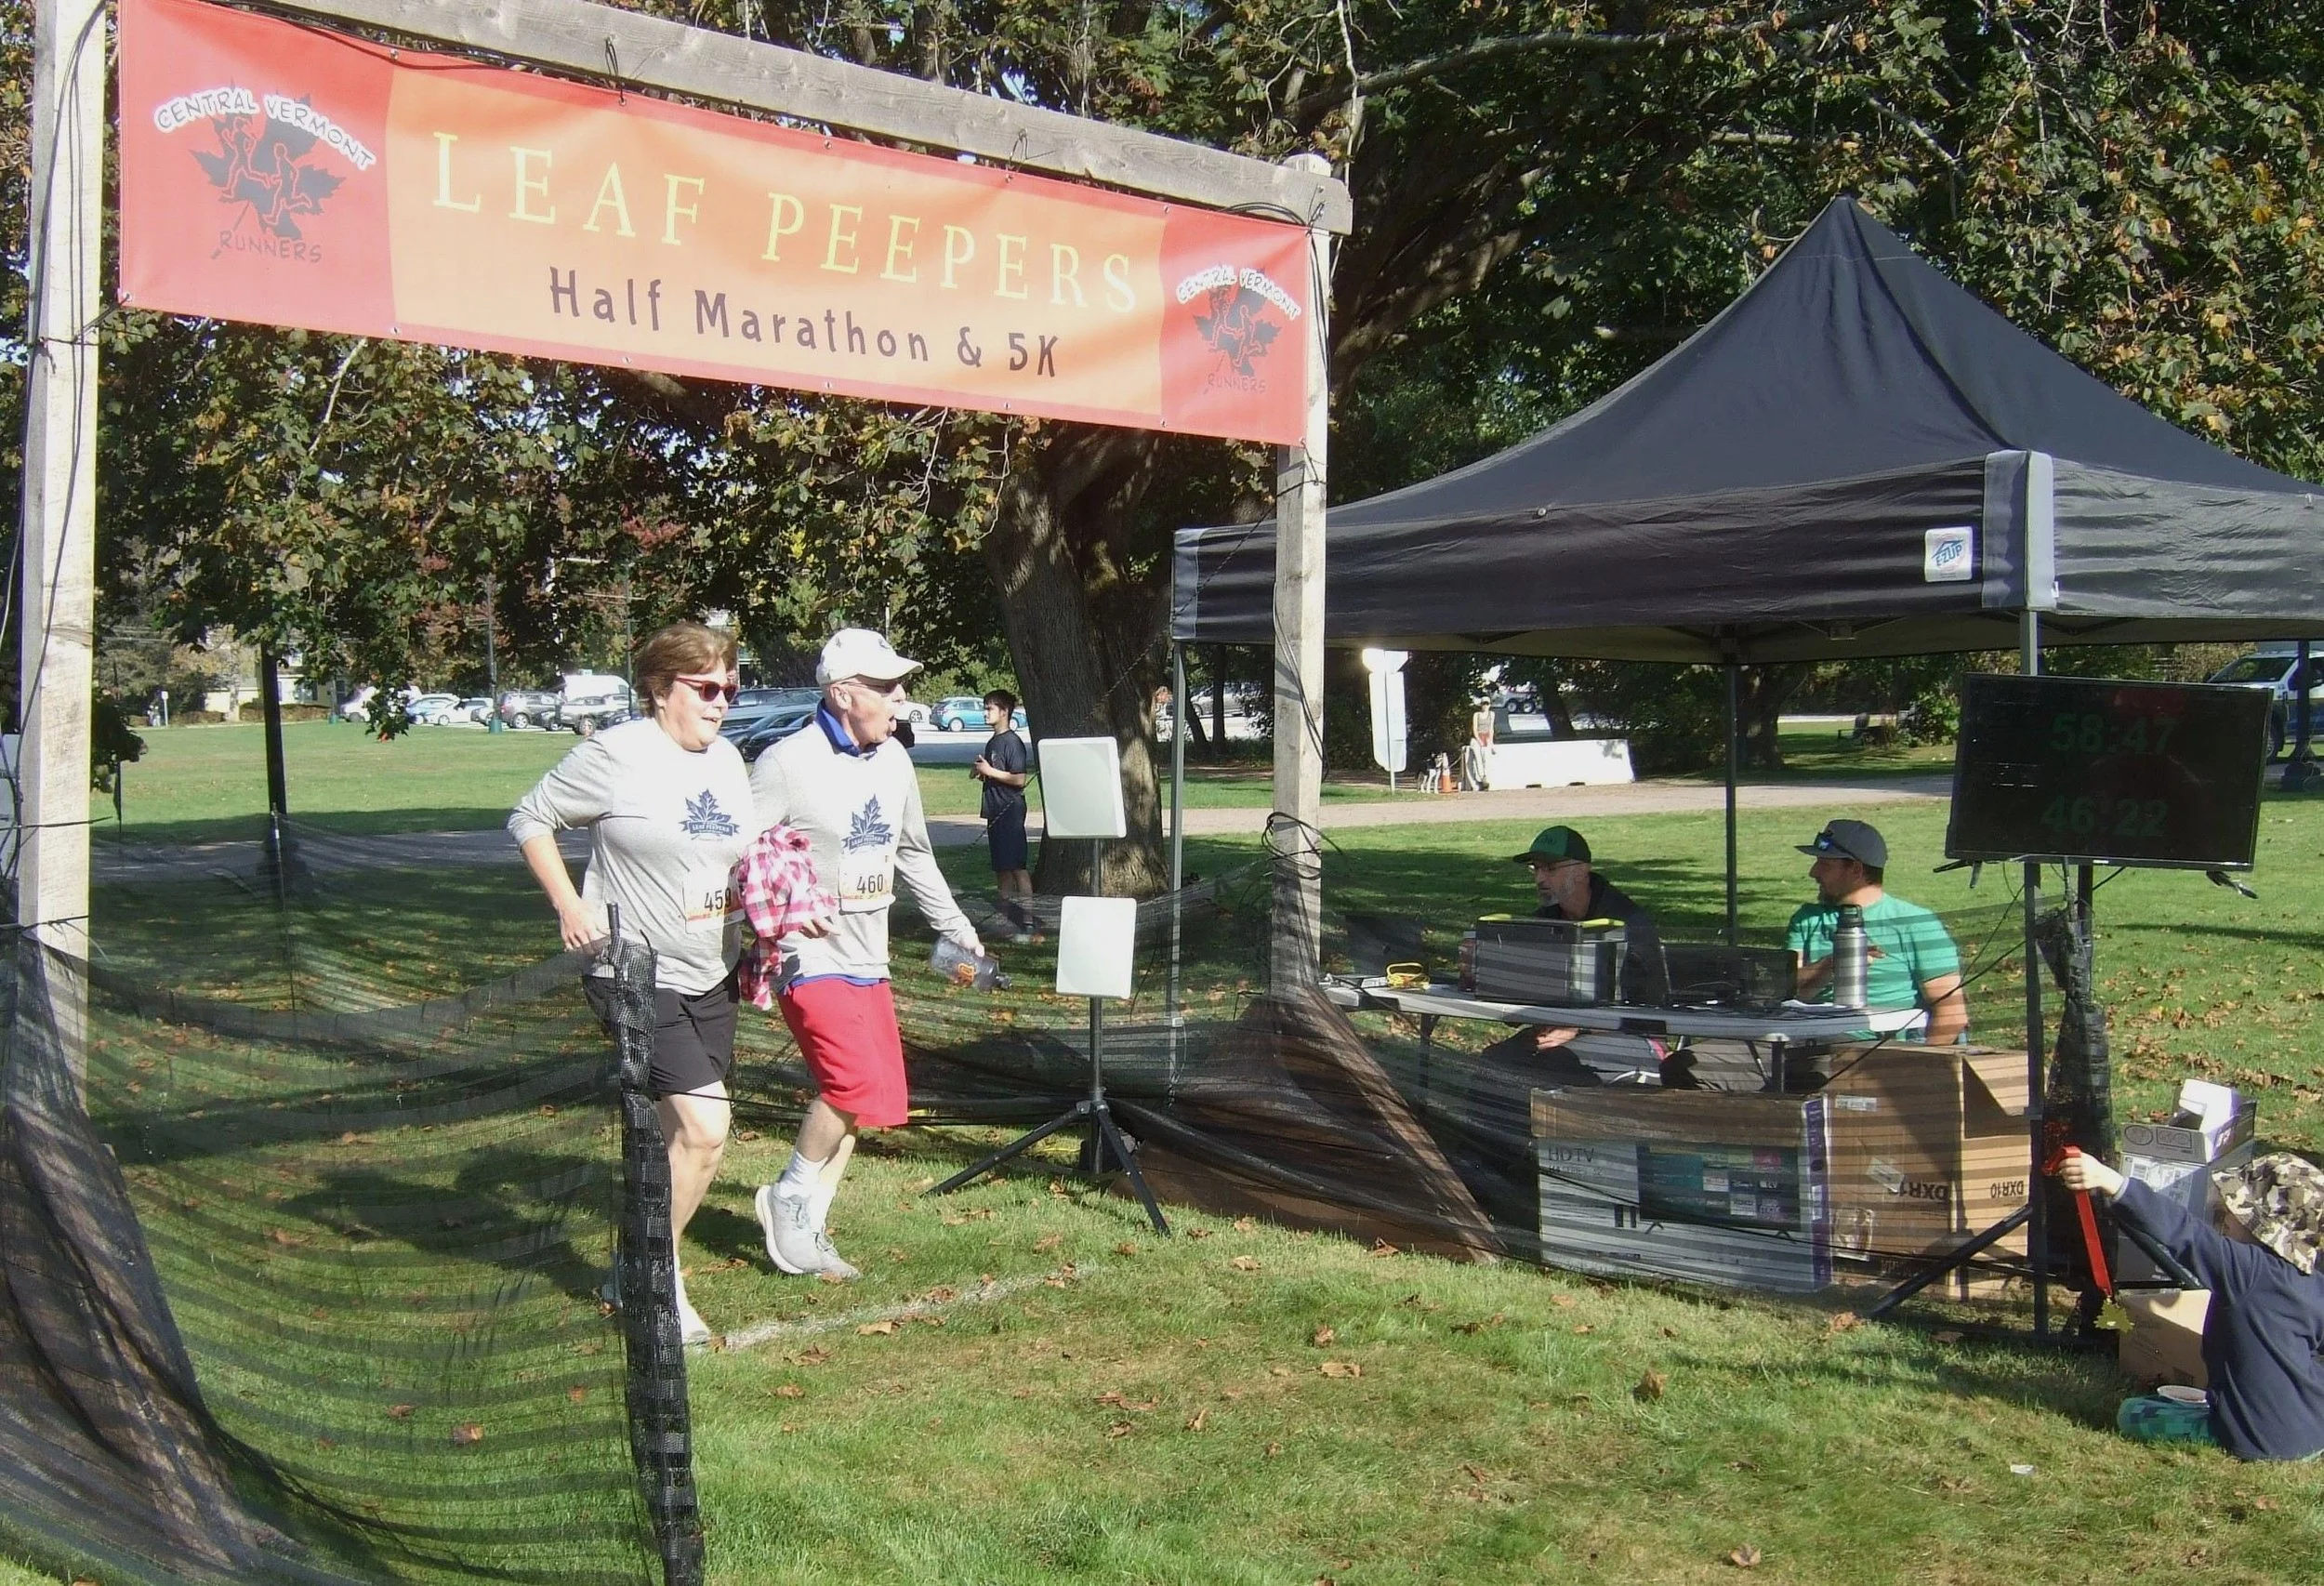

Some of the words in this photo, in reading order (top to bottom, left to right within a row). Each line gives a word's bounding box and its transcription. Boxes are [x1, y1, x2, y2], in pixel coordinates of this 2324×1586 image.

[155, 88, 259, 130] CENTRAL
[266, 95, 376, 170] VERMONT
[432, 131, 706, 245] LEAF
[761, 192, 1137, 313] PEEPERS
[218, 229, 324, 264] RUNNERS
[1239, 268, 1301, 319] VERMONT
[549, 265, 661, 331] Half
[694, 288, 930, 363] Marathon
[957, 325, 983, 368] &
[1008, 333, 1059, 378] 5K
[1208, 372, 1267, 393] RUNNERS
[2050, 712, 2180, 755] 58:47
[704, 887, 732, 911] 459
[856, 874, 884, 894] 460
[1887, 1181, 1948, 1204] DXR1
[1990, 1180, 2024, 1198] DXR10
